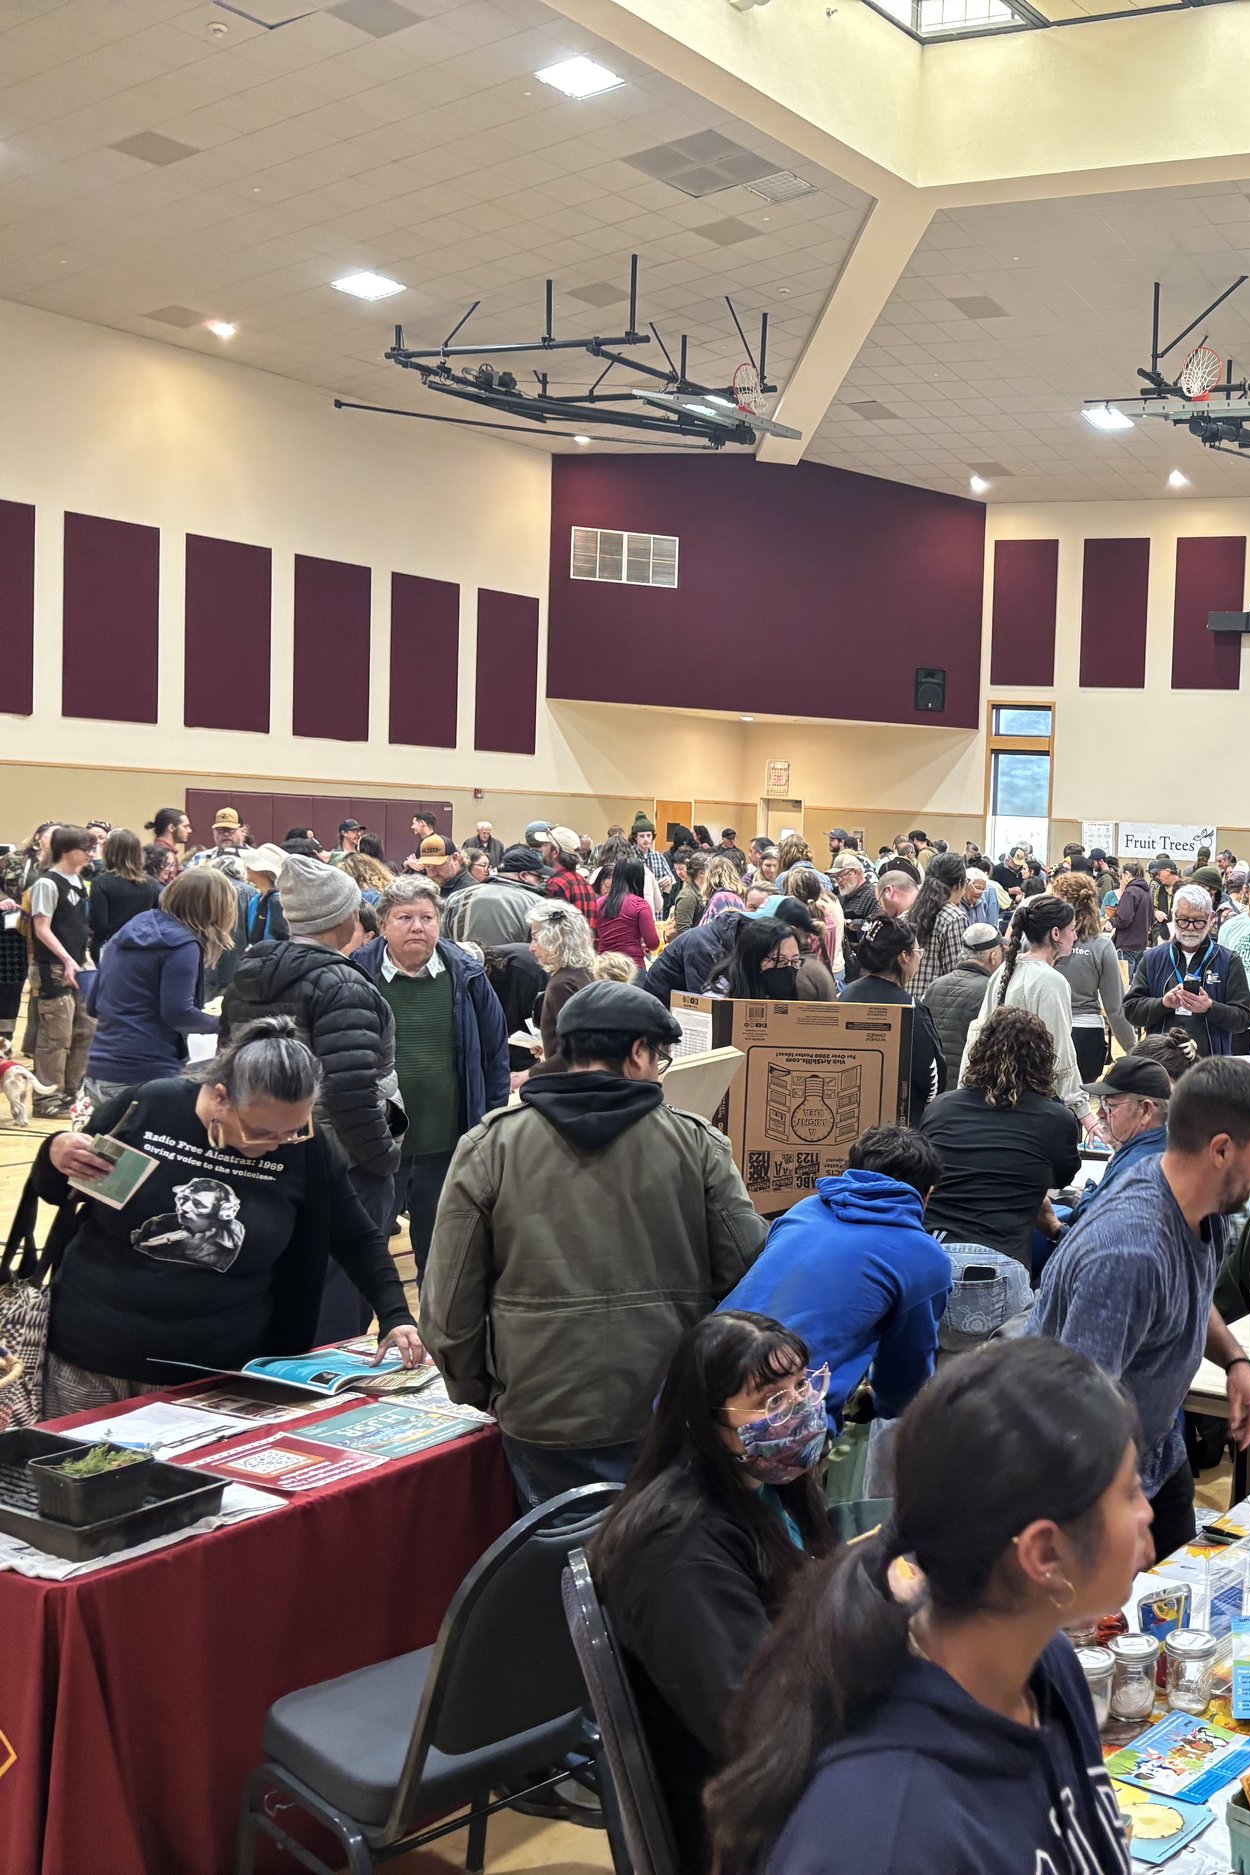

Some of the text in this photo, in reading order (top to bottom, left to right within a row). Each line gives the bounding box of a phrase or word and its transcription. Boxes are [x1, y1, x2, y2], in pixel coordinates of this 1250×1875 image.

[1124, 834, 1195, 852] Fruit Trees
[785, 1057, 831, 1065] ArtSkills.com
[803, 1108, 825, 1117] IDEA
[796, 1118, 829, 1127] BRIGHT
[143, 1131, 285, 1172] Radio Free Alcatraz: 1969
[143, 1143, 277, 1181] Giving voice to the voiceless.
